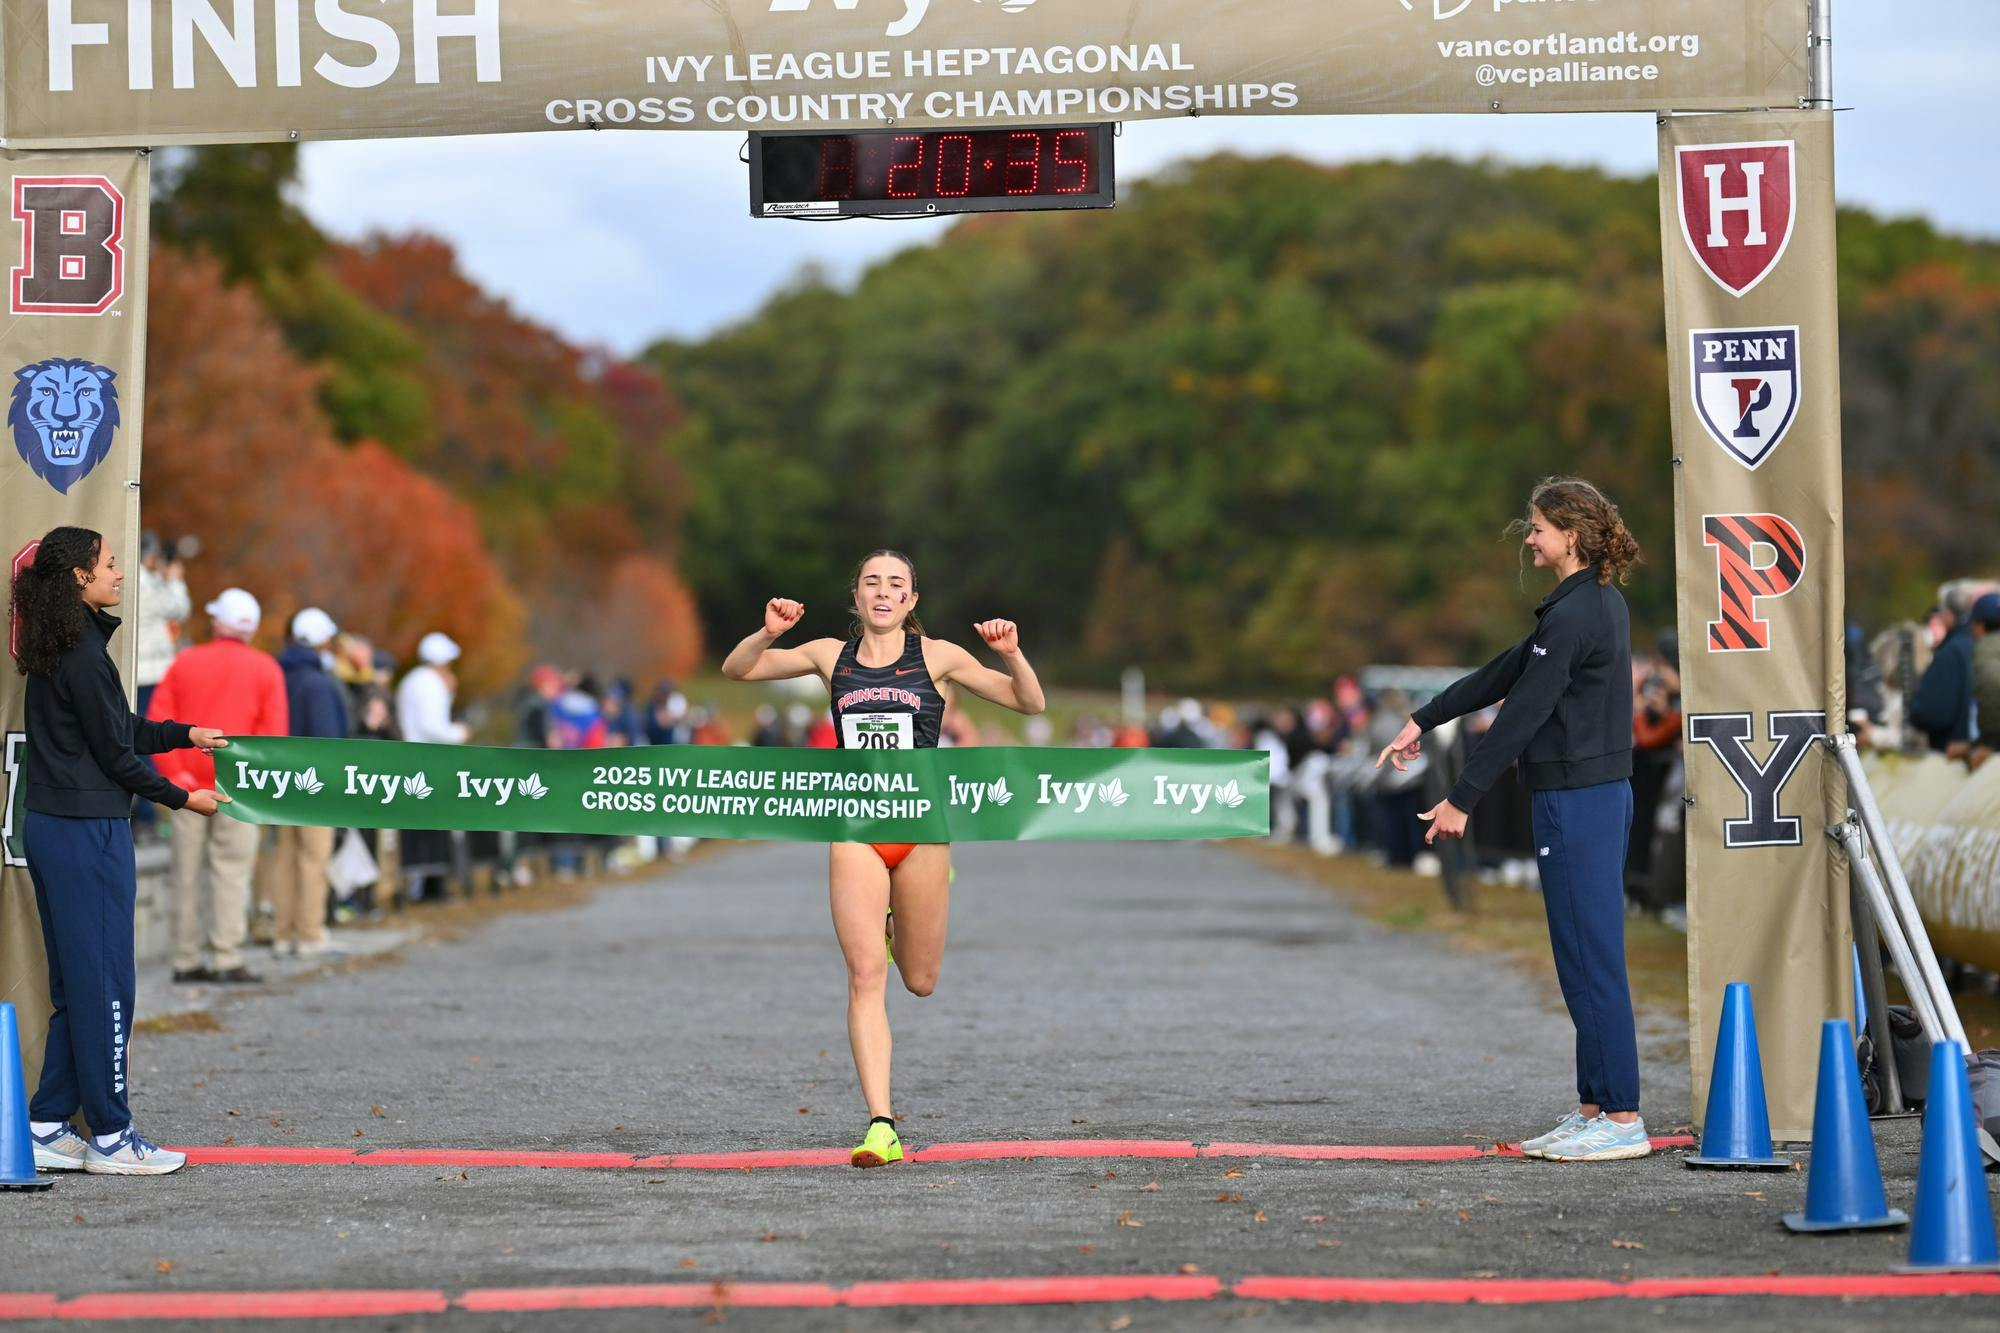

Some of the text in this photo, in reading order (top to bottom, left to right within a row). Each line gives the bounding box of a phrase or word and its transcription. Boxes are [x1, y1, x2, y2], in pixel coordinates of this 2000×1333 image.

[48, 0, 502, 92] FINISH
[646, 43, 1195, 83] IVY LEAGUE HEPTAGONAL
[1437, 31, 1699, 57] vancortlandt.org
[1475, 62, 1659, 87] @vcpalliance
[545, 82, 1299, 124] CROSS COUNTRY CHAMPIONSHIPS
[1703, 161, 1767, 248] H
[10, 175, 125, 316] B
[1702, 338, 1788, 363] PENN
[1731, 378, 1772, 438] P
[1702, 513, 1806, 652] P
[837, 687, 921, 714] PRINCETON
[235, 761, 291, 799] Ivy
[344, 765, 401, 804] Ivy
[456, 771, 515, 806] Ivy
[592, 767, 919, 792] 2025 IVY LEAGUE HEPTAGONAL
[948, 775, 986, 813] Ivy
[1037, 774, 1096, 813] Ivy
[1153, 775, 1212, 814] Ivy
[1688, 710, 1827, 849] Y
[581, 791, 932, 819] CROSS COUNTRY CHAMPIONSHIP
[112, 1000, 124, 1093] COLUMBIA
